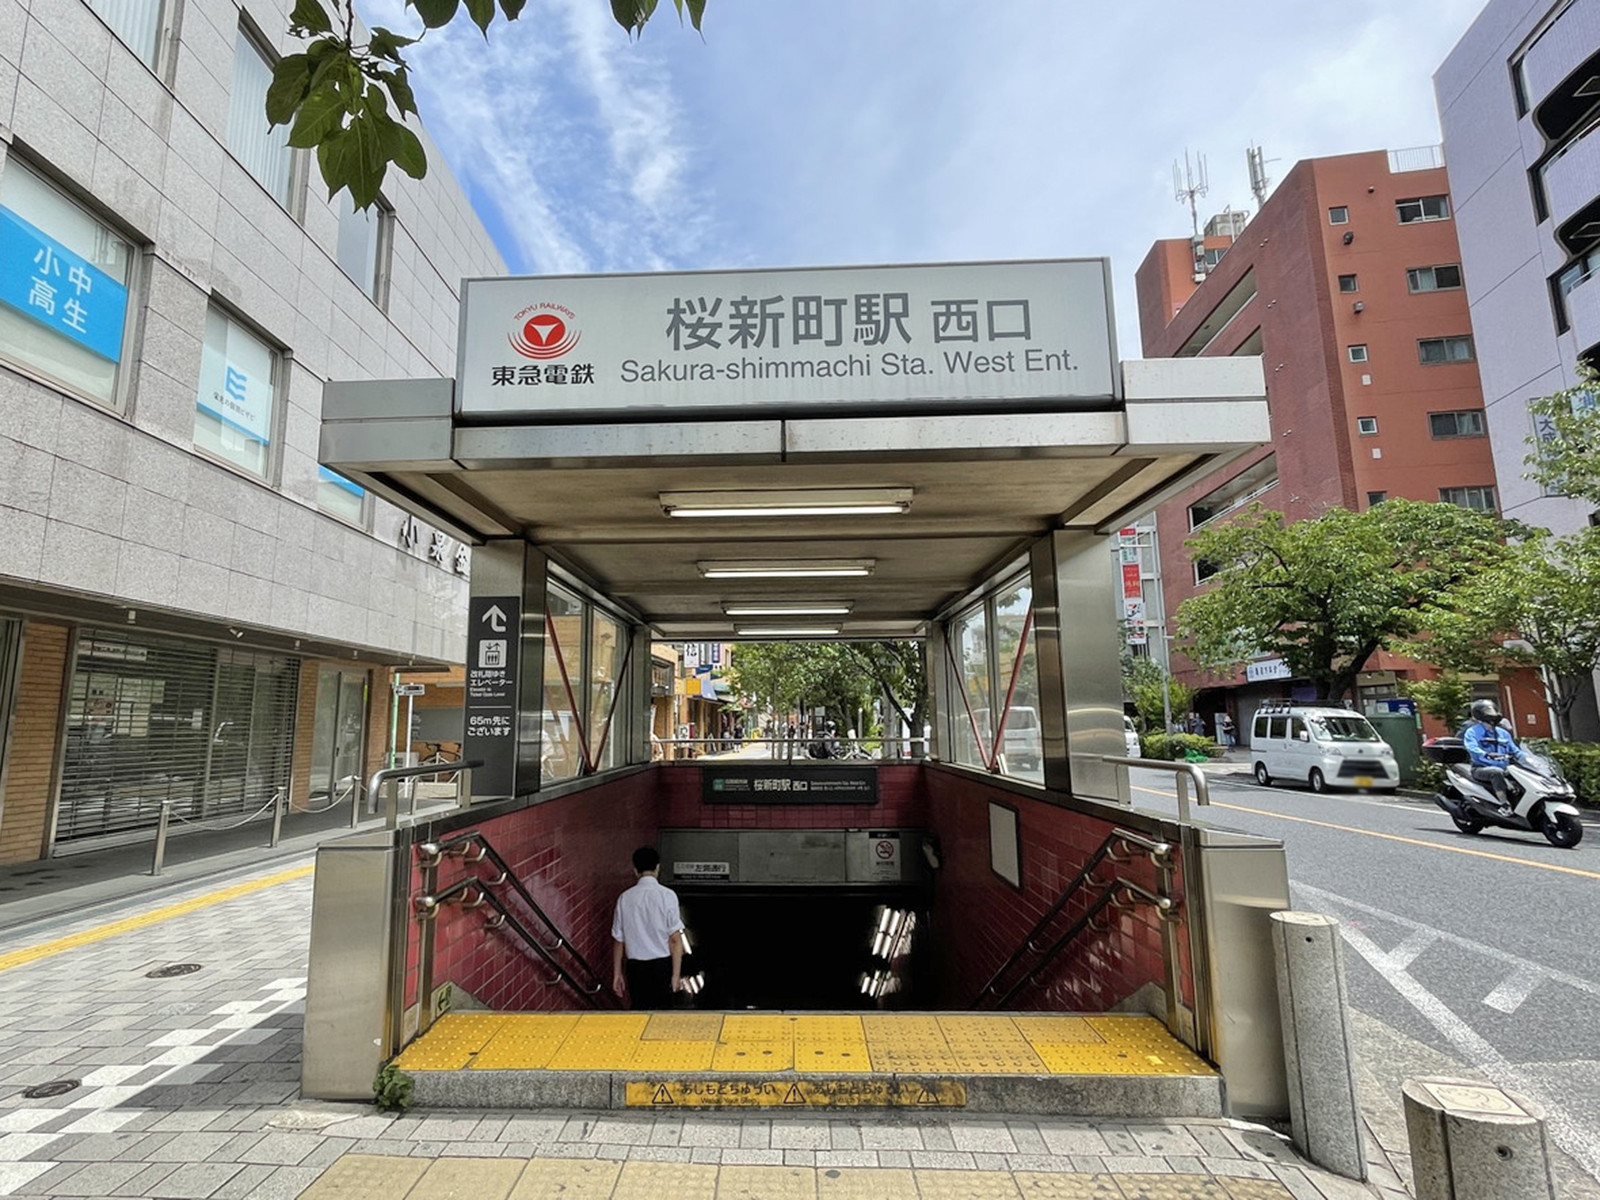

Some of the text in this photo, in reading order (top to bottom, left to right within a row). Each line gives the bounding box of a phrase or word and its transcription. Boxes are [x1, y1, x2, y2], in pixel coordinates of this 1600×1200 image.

[514, 302, 576, 321] TOKYU RAILWAYS
[666, 293, 1031, 350] 桜新町駅 西口
[491, 363, 595, 386] 東急電鉄
[620, 349, 1078, 382] Sakura-shimmachi Sta. West Ent.
[470, 679, 513, 687] エレベーター
[470, 716, 510, 726] 65m先に
[467, 726, 512, 737] ございます
